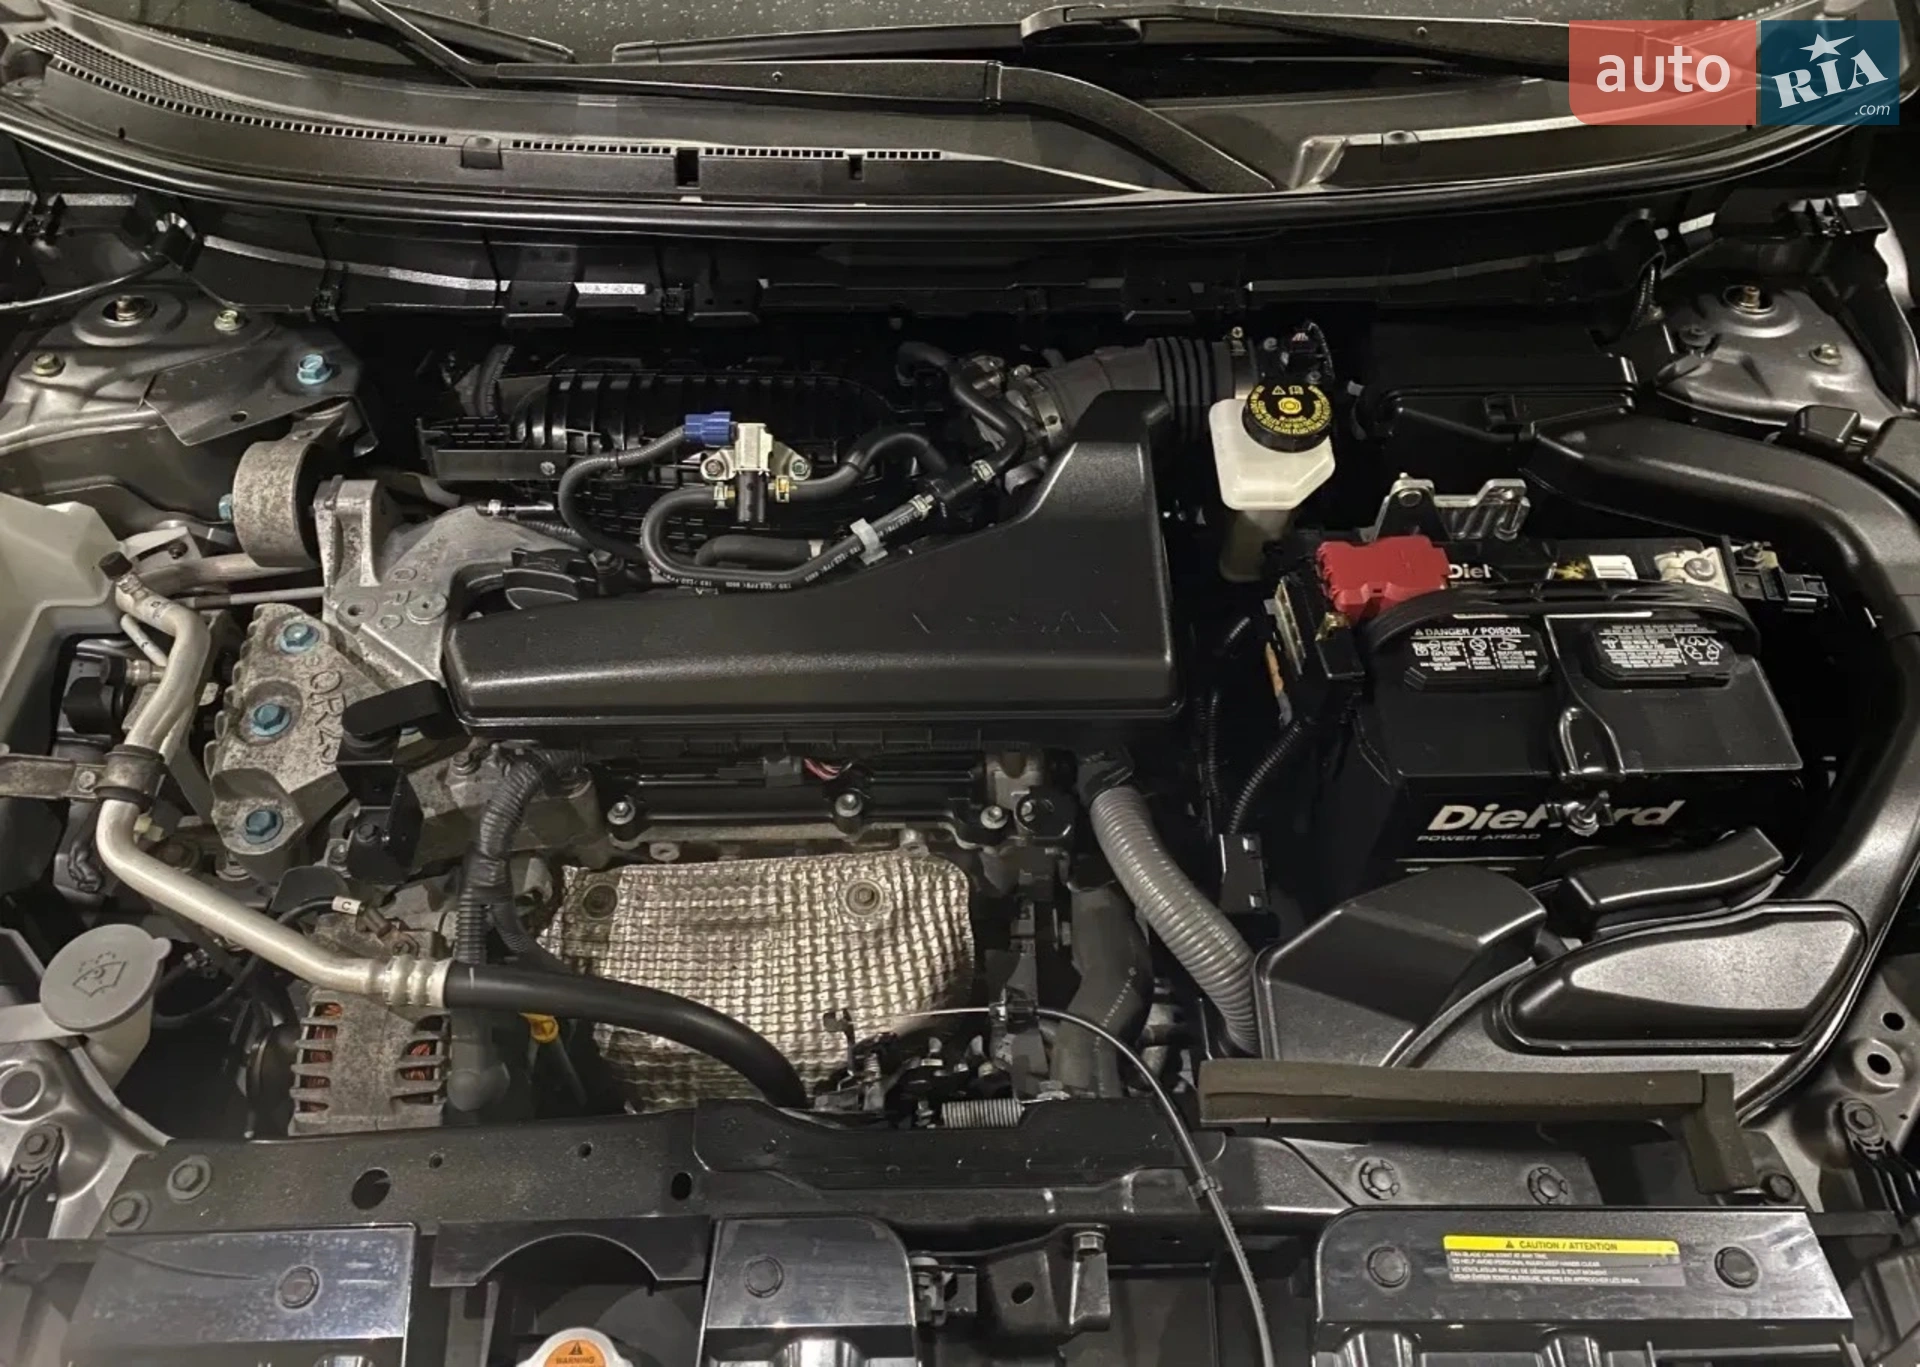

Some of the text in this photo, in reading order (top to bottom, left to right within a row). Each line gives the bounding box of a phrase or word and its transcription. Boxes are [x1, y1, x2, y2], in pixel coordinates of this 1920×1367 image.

[1425, 627, 1470, 636] DANGER
[1481, 626, 1522, 636] POISON
[1417, 833, 1541, 842] POWER AHEAD
[1519, 1241, 1560, 1250] CAUTION
[1569, 1242, 1618, 1251] ATTENTION
